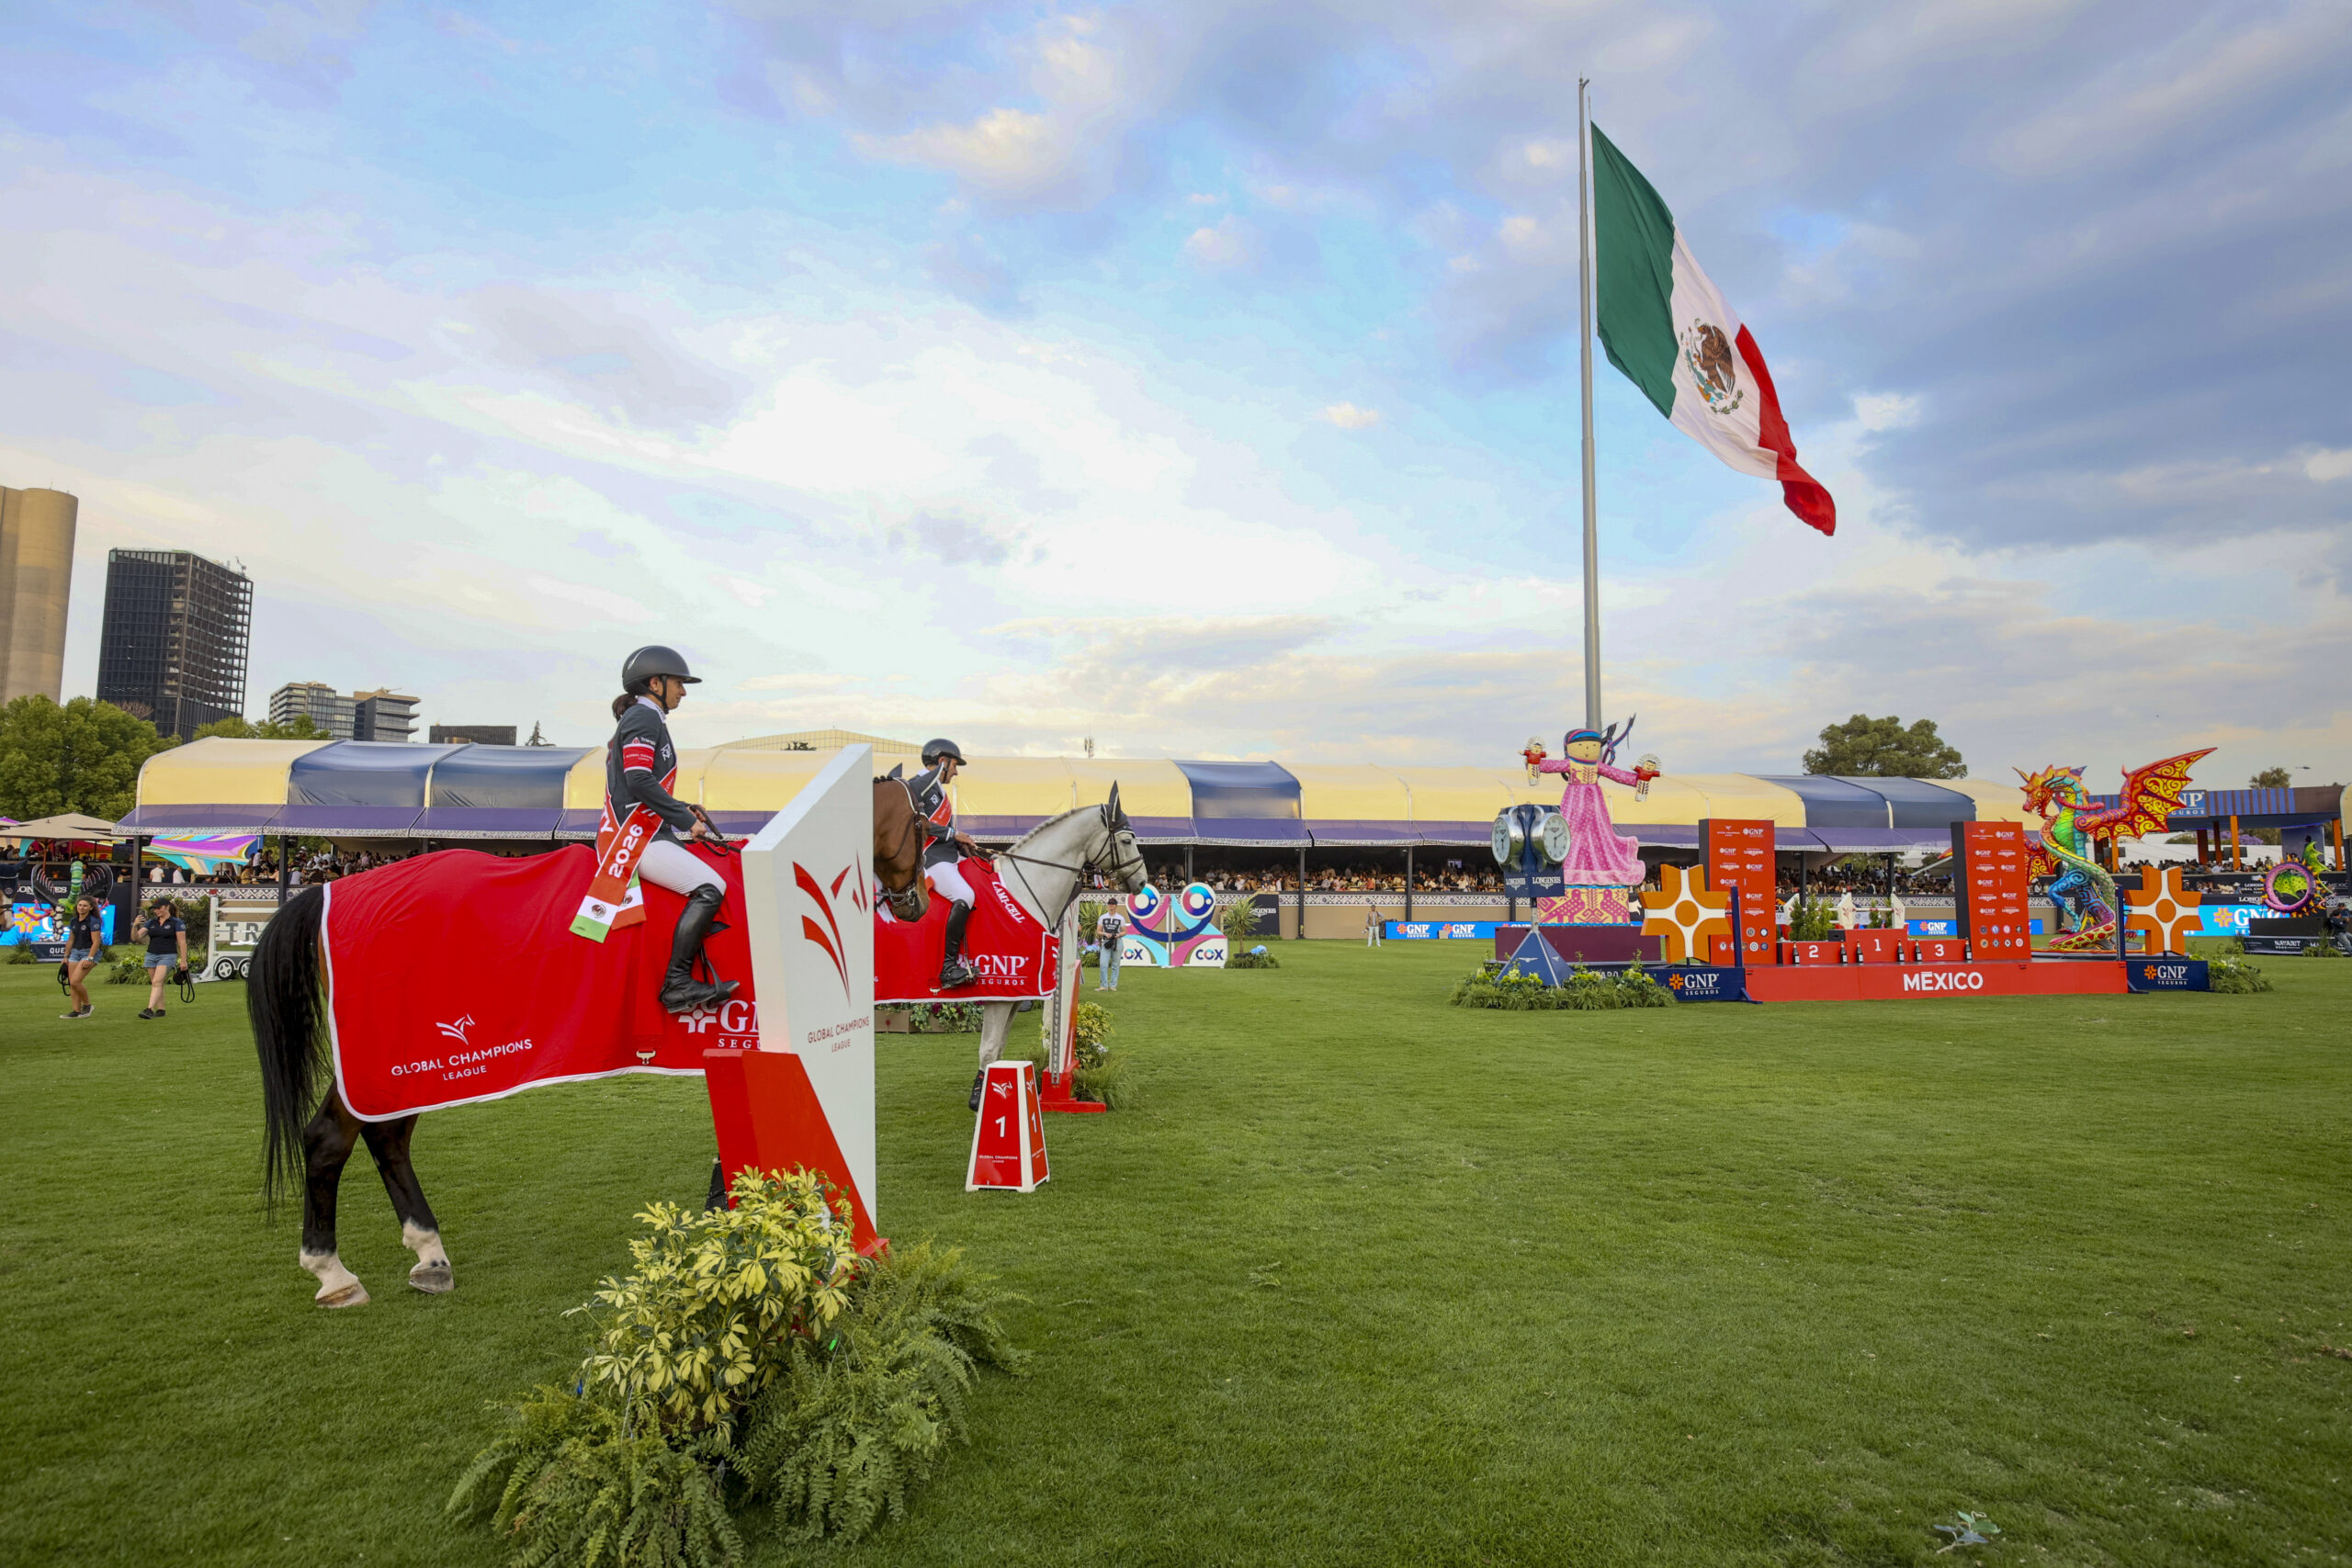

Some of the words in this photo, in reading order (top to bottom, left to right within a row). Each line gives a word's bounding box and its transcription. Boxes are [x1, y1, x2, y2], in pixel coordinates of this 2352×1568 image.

[2177, 793, 2203, 807] NP
[608, 824, 644, 878] 2026
[991, 882, 1025, 923] LAMI-CELL
[1407, 924, 1430, 933] GNP
[1453, 924, 1476, 933] GNP
[1928, 921, 1948, 931] GNP
[1809, 944, 1819, 958] 2
[1874, 939, 1882, 952] 1
[1935, 943, 1945, 957] 3
[1121, 949, 1144, 961] OX
[1195, 949, 1225, 961] COX
[974, 954, 1025, 976] GNP
[2157, 965, 2187, 979] GNP
[1684, 974, 1718, 988] GNP
[808, 1028, 834, 1043] GLOBAL
[835, 1016, 870, 1036] CHAMPIONS
[831, 1039, 851, 1053] LEAGUE
[390, 1057, 445, 1077] GLOBAL
[448, 1039, 533, 1066] CHAMPIONS
[443, 1065, 488, 1081] LEAGUE
[995, 1115, 1006, 1137] 1
[1031, 1111, 1037, 1134] 1
